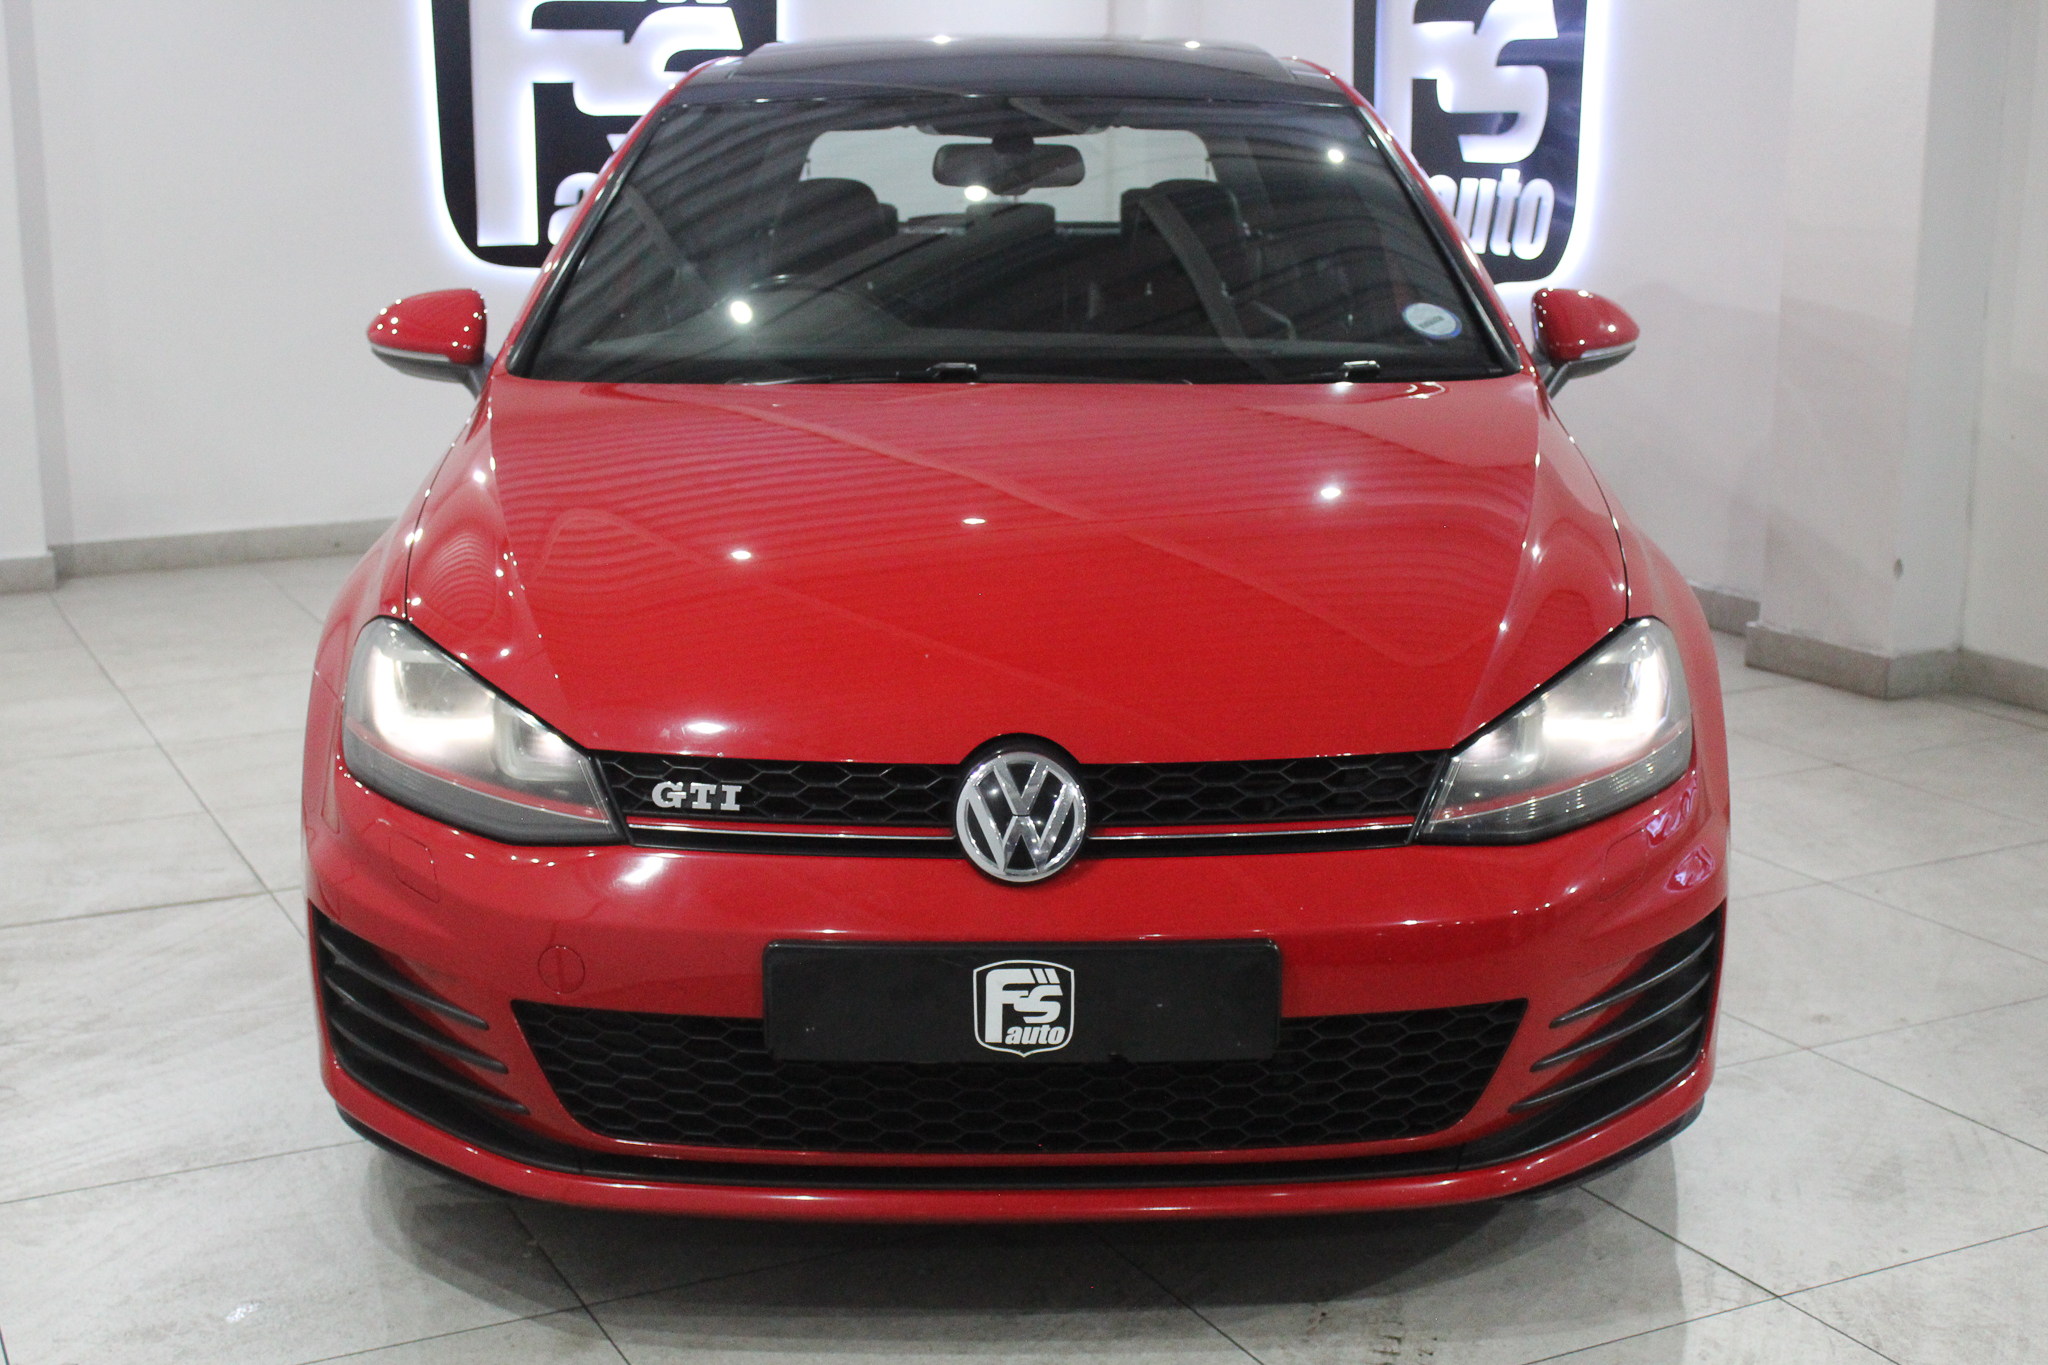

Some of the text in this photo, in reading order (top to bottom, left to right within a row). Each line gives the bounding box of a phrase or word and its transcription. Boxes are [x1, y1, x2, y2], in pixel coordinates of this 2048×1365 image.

[651, 781, 742, 811] GTI
[985, 968, 1063, 1043] FS
[1005, 1024, 1066, 1045] auto
